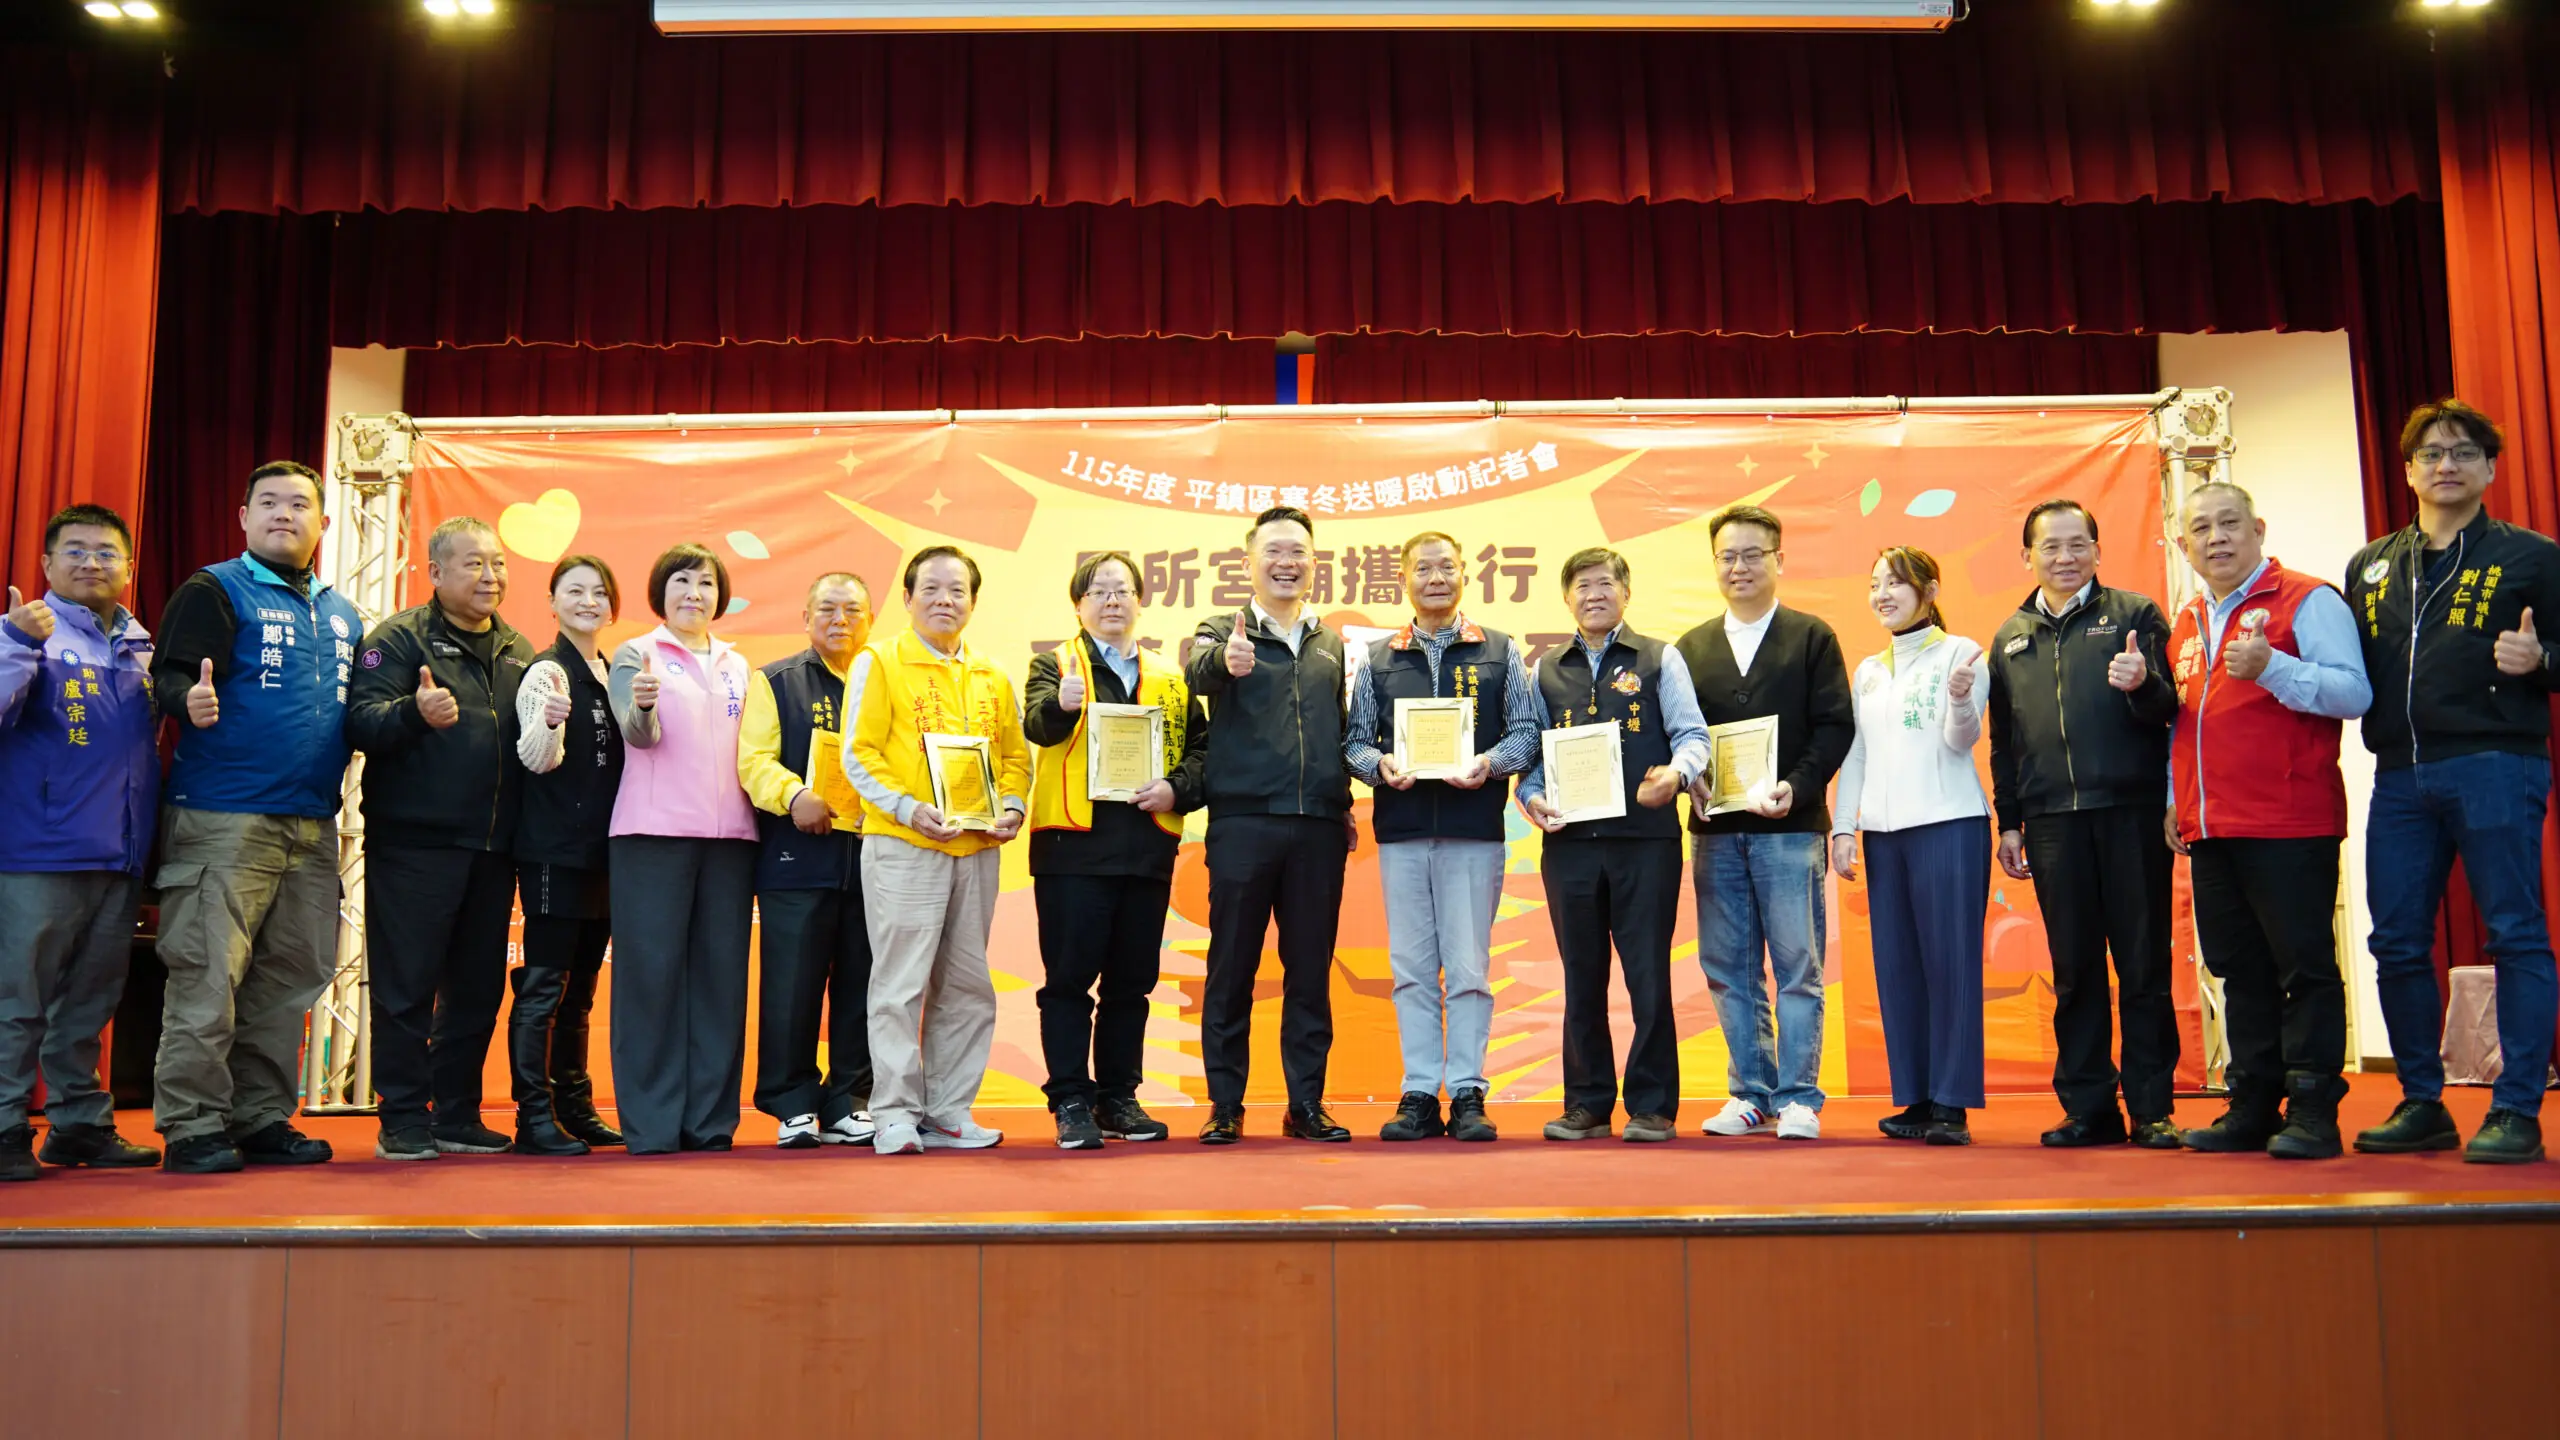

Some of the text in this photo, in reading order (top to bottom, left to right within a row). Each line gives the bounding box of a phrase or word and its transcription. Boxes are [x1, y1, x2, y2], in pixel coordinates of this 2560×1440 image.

[1061, 441, 1560, 514] 115年度 平鎮區寒冬送暖啟動記者會
[1076, 543, 1538, 609] 所宮攜行
[2447, 569, 2480, 626] 劉仁照
[2473, 564, 2502, 630] 桃園市議員
[82, 667, 101, 696] 助理
[259, 623, 284, 690] 鄭皓仁
[64, 678, 91, 746] 盧宗廷
[812, 702, 826, 730] 陳新
[1627, 701, 1641, 733] 中壢
